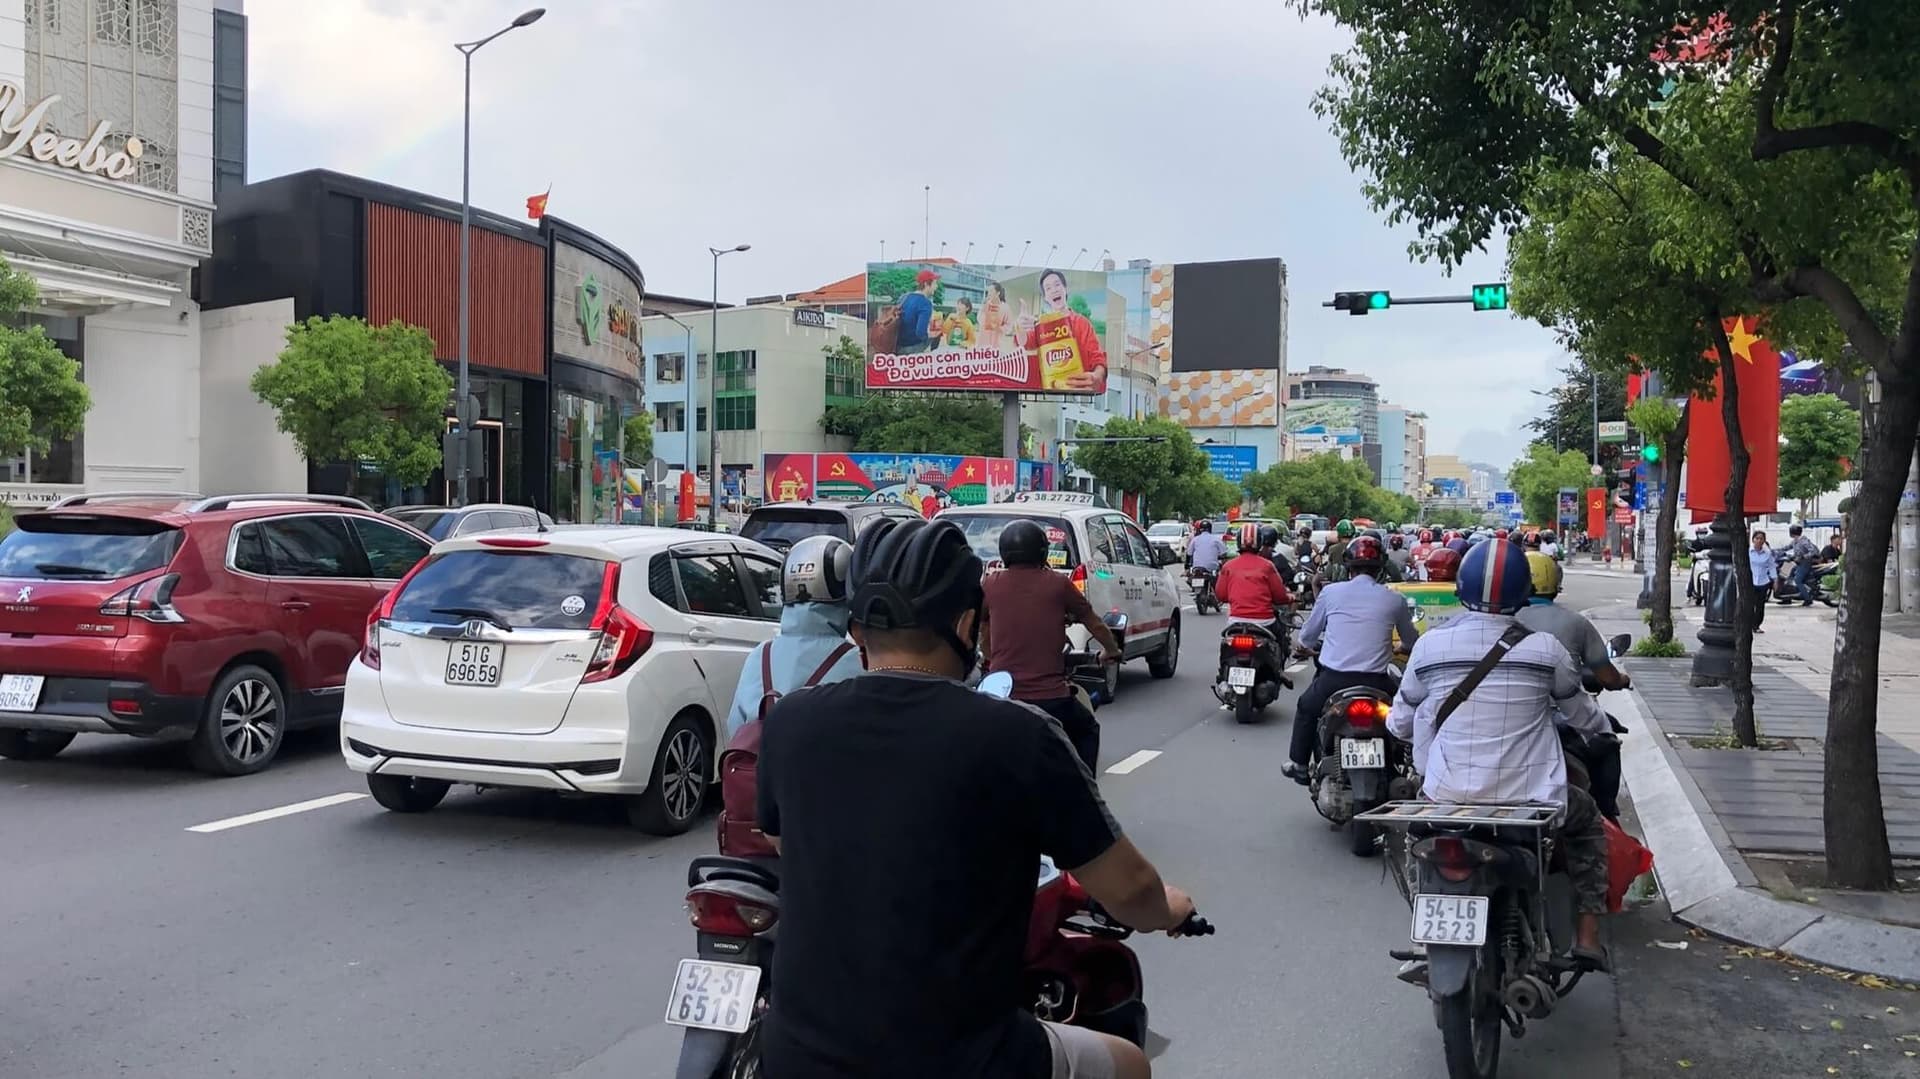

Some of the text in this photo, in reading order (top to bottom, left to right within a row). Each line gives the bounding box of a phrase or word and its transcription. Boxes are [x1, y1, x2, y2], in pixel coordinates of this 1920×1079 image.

[0, 80, 135, 179] Yeebo
[1475, 286, 1505, 308] 44
[796, 311, 824, 324] AIKIDO
[900, 353, 933, 368] ngon
[913, 364, 933, 377] vui
[462, 644, 490, 663] 51G
[448, 662, 497, 683] 696.59
[1425, 899, 1477, 919] 54-L6
[1422, 920, 1476, 941] 2523
[714, 942, 739, 950] HONDA
[686, 965, 745, 997] 52-S1
[679, 994, 741, 1026] 6516
